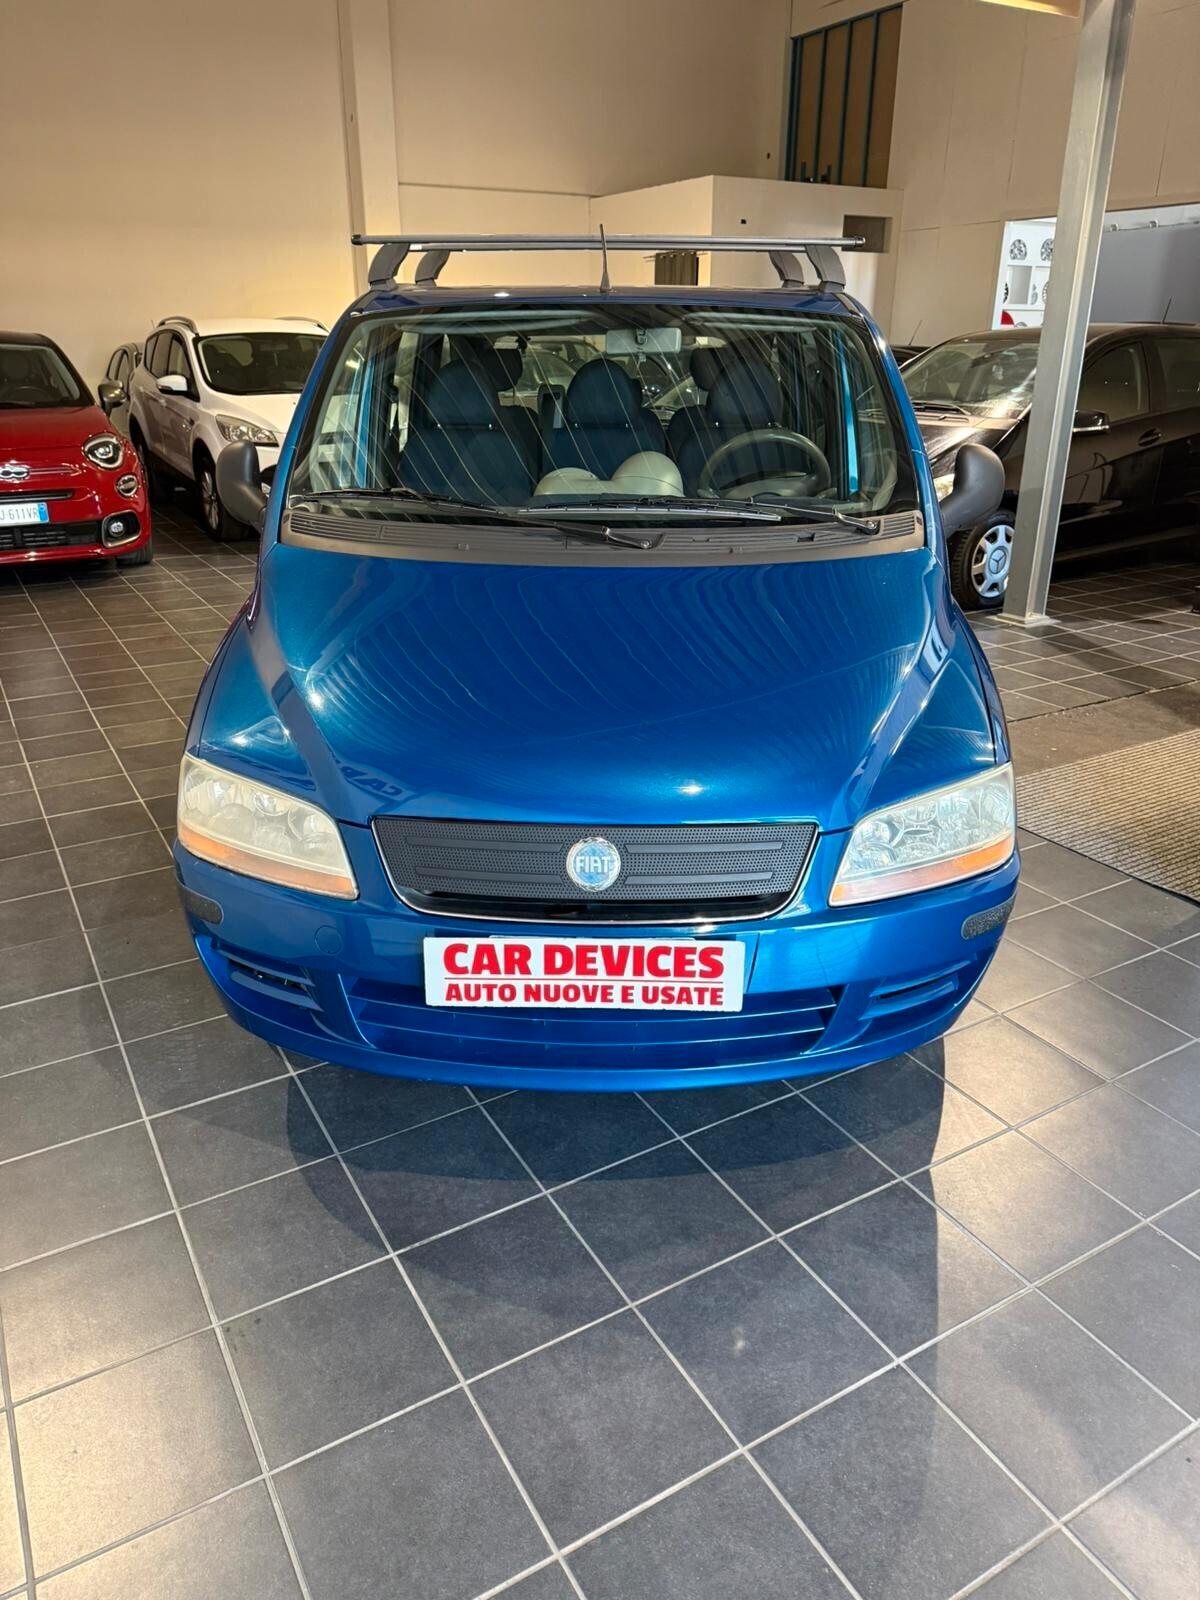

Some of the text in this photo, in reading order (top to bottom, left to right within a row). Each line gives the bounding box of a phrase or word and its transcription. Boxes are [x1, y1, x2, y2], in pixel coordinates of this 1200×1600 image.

[575, 855, 611, 873] FIAT
[443, 943, 724, 979] CAR DEVICES
[445, 983, 724, 1006] AUTO NUOVE E USATE
